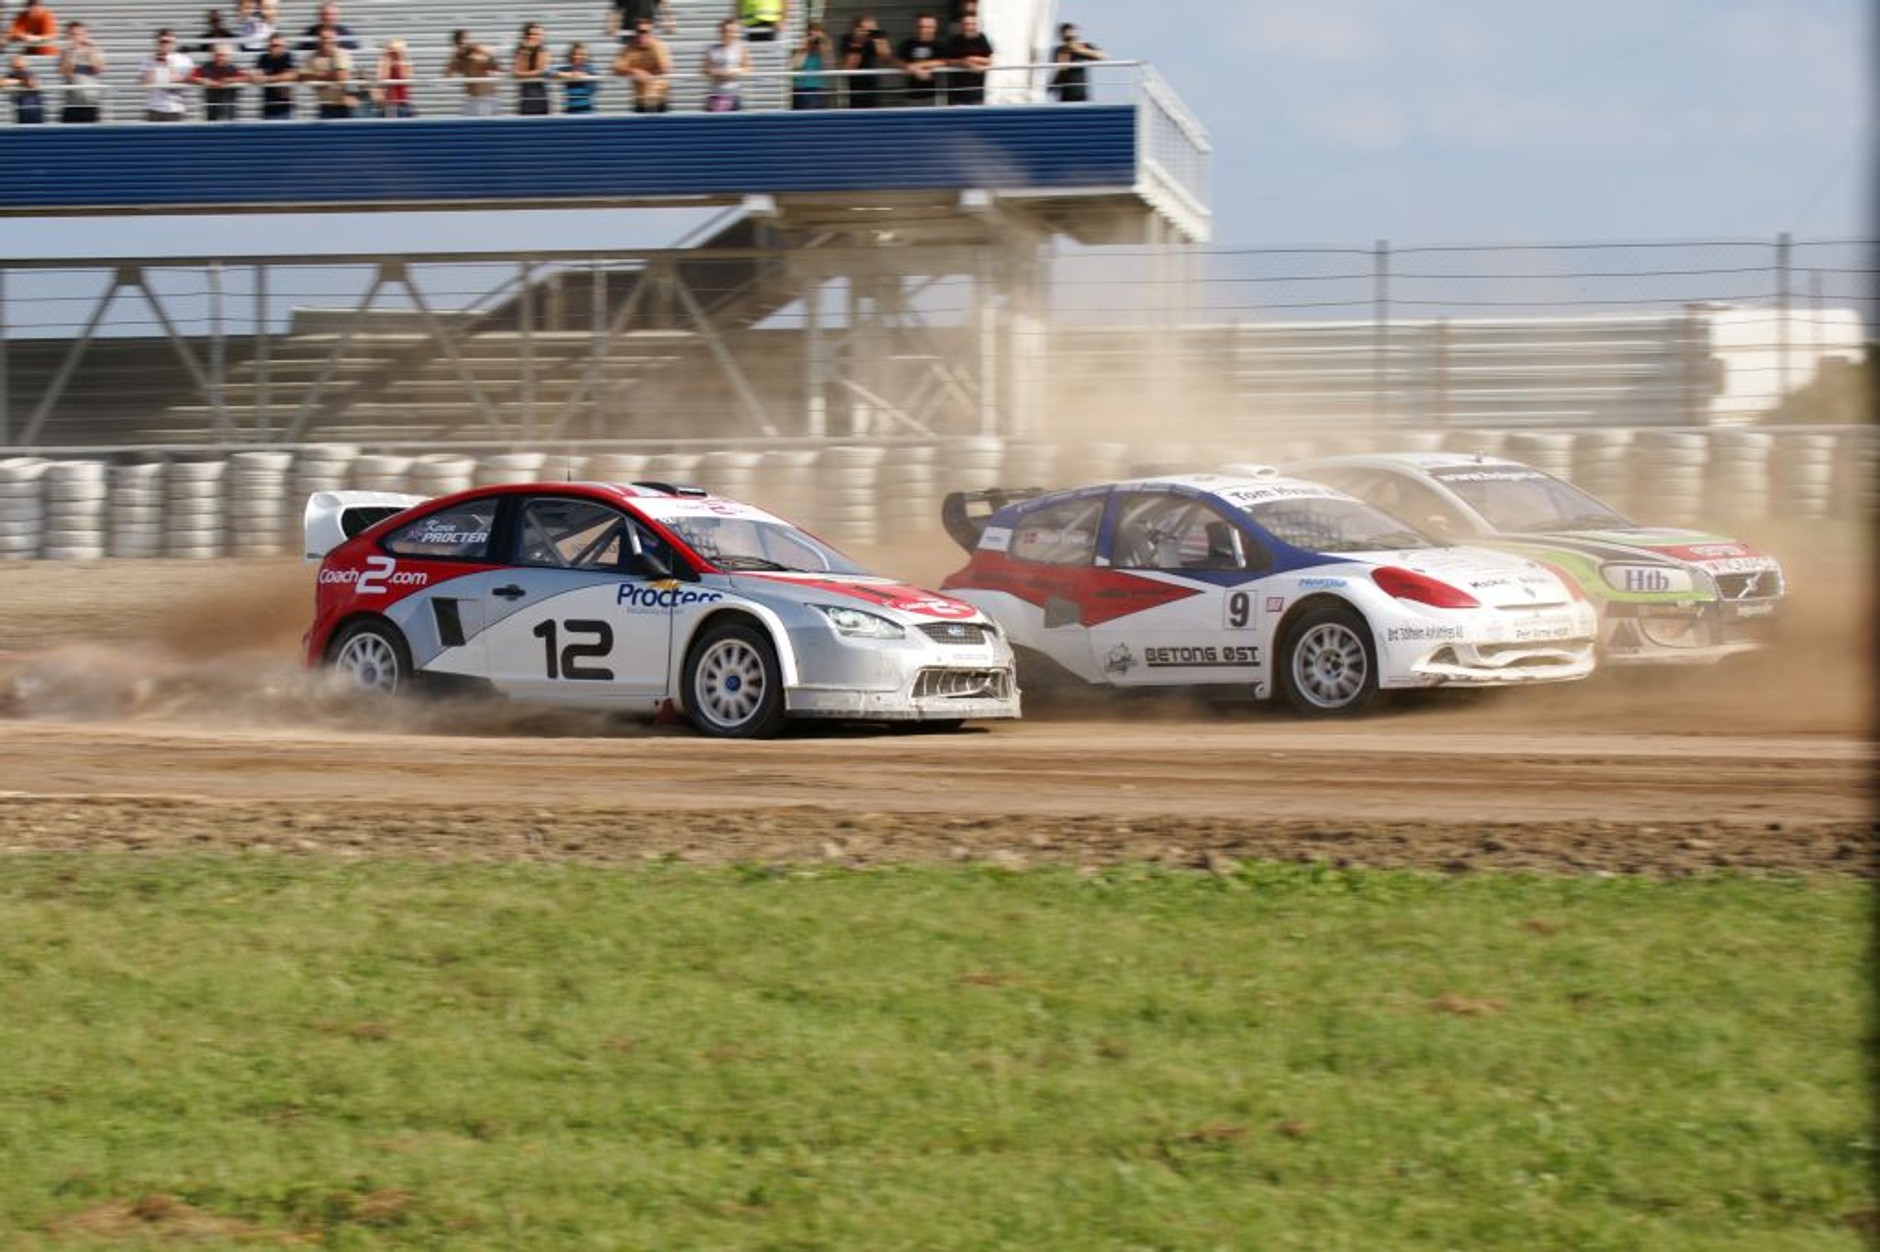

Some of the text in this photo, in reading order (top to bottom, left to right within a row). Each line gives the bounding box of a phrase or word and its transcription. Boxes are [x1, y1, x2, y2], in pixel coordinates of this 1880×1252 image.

[421, 532, 488, 543] PROCTER
[320, 555, 427, 594] Coach2.com
[1625, 569, 1669, 591] Hth
[1230, 592, 1250, 628] 9
[533, 618, 614, 680] 12
[1145, 646, 1217, 662] BETONG
